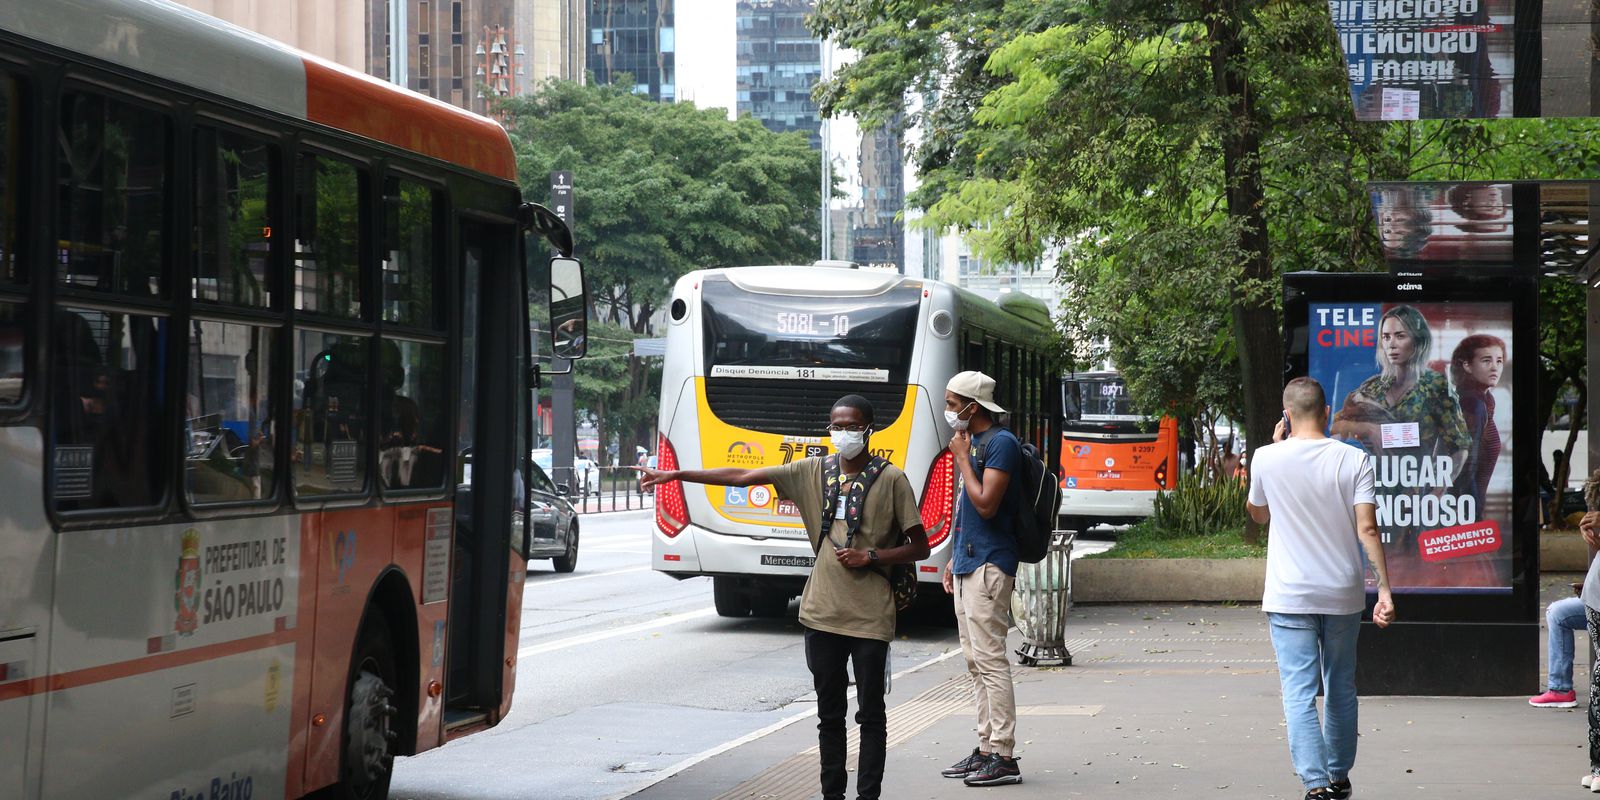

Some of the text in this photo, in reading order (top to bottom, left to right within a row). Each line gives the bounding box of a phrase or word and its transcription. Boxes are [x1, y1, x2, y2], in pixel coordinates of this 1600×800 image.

[1316, 308, 1375, 326] TELE
[1316, 328, 1375, 347] CINE
[716, 367, 746, 375] Disque
[796, 369, 816, 378] 181
[807, 447, 822, 456] SP
[1370, 455, 1453, 487] LUGAR
[771, 528, 801, 536] Mantenha
[1424, 528, 1494, 547] LANÇAMENTO
[1426, 536, 1496, 555] EXCLUSIVO
[205, 537, 287, 574] PREFEITURA DE
[203, 578, 284, 625] SÃO PAULO
